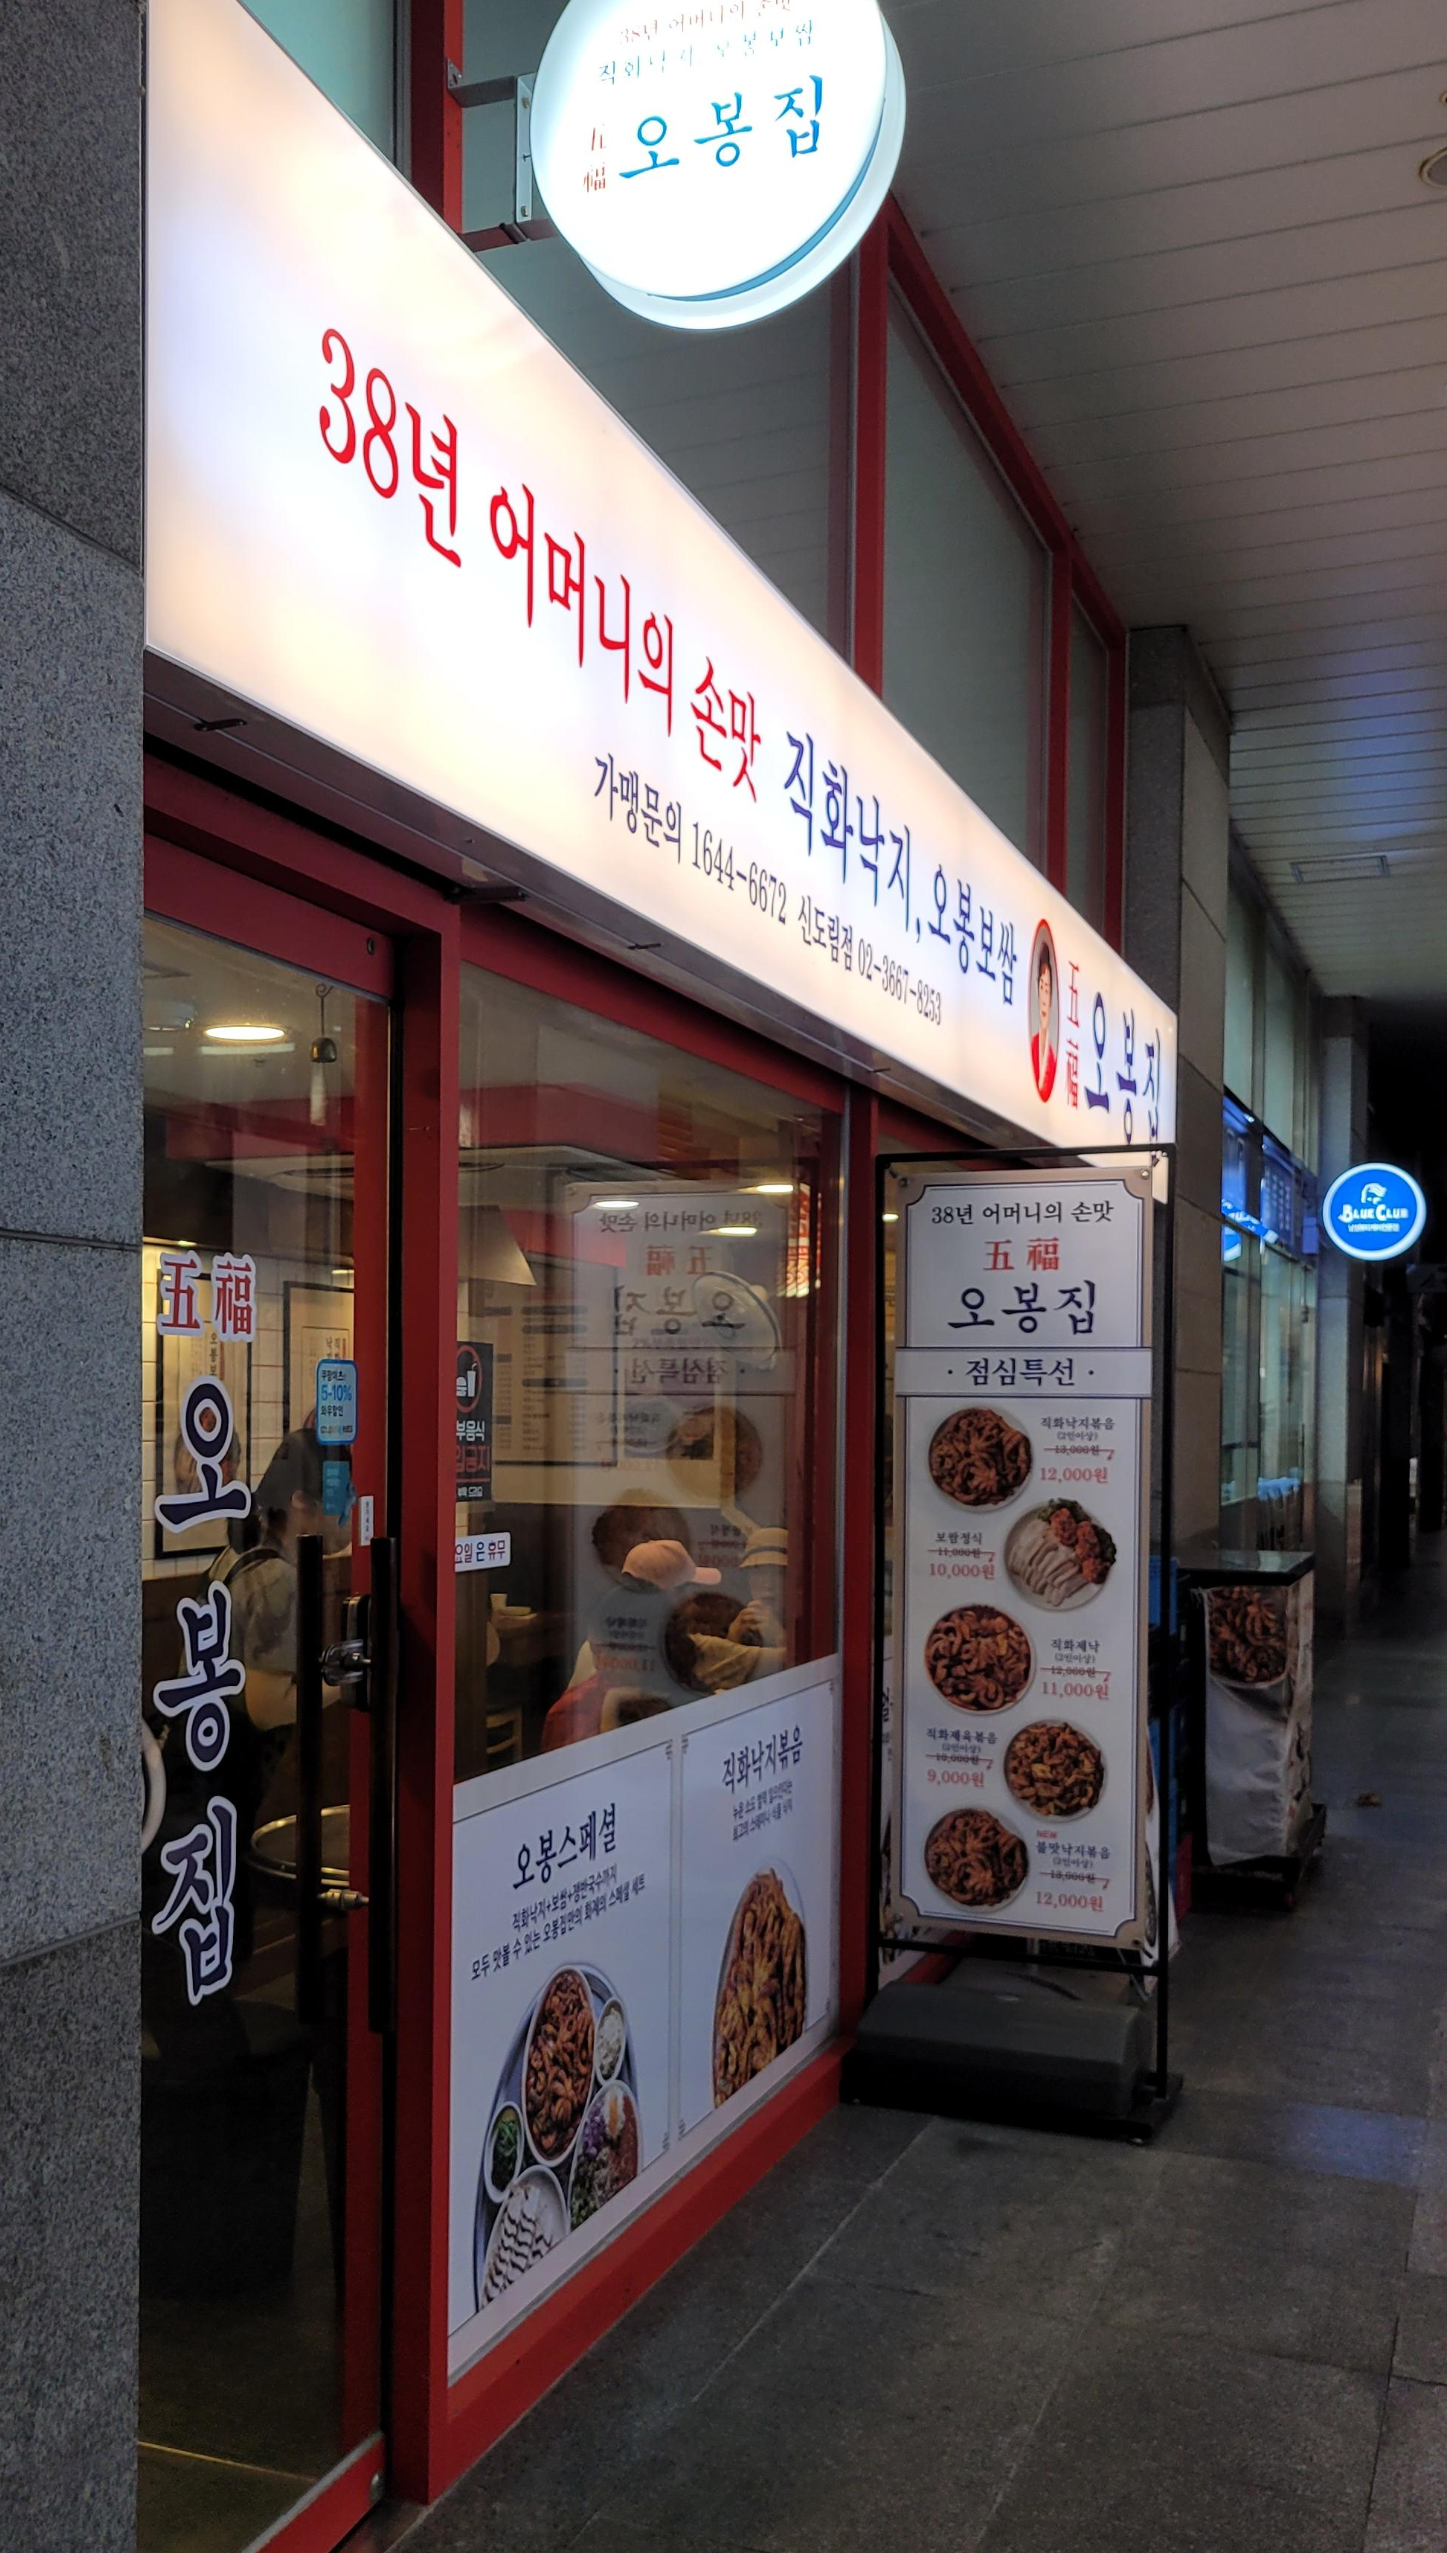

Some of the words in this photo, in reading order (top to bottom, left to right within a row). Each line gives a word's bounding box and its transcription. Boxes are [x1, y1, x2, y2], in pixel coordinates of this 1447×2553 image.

[618, 74, 824, 178] 오봉집
[319, 328, 462, 568] 38년
[490, 483, 674, 737] 어머니의
[690, 656, 763, 803] 손맛
[594, 752, 683, 864] 가맹문의
[691, 822, 787, 925] 1644-6672
[798, 894, 854, 972] 신도림점
[857, 937, 942, 1026] 02-3667-8253
[931, 1203, 975, 1225] 38년
[982, 1200, 1064, 1225] 어머니의
[1070, 1200, 1115, 1224] 손맛
[983, 1236, 1060, 1272] 五福
[160, 1257, 254, 1337] 五福
[947, 1279, 1097, 1336] 오봉집
[965, 1357, 1077, 1387] 점심특선
[320, 1384, 353, 1401] 5-10%
[1040, 1416, 1116, 1431] 직화낙지볶음
[1040, 1466, 1109, 1485] 12,000원
[928, 1562, 996, 1580] 10,000원
[156, 1380, 250, 1998] 오봉집
[1041, 1681, 1110, 1701] 11,000원
[926, 1726, 998, 1745] 직화제육볶음
[722, 1723, 804, 1795] 직화낙지볶음
[926, 1768, 985, 1788] 9,000원
[511, 1801, 616, 1891] 오봉스페셜
[1036, 1890, 1105, 1913] 12,000원
[470, 1953, 490, 1981] 모두
[512, 1936, 523, 1961] 수
